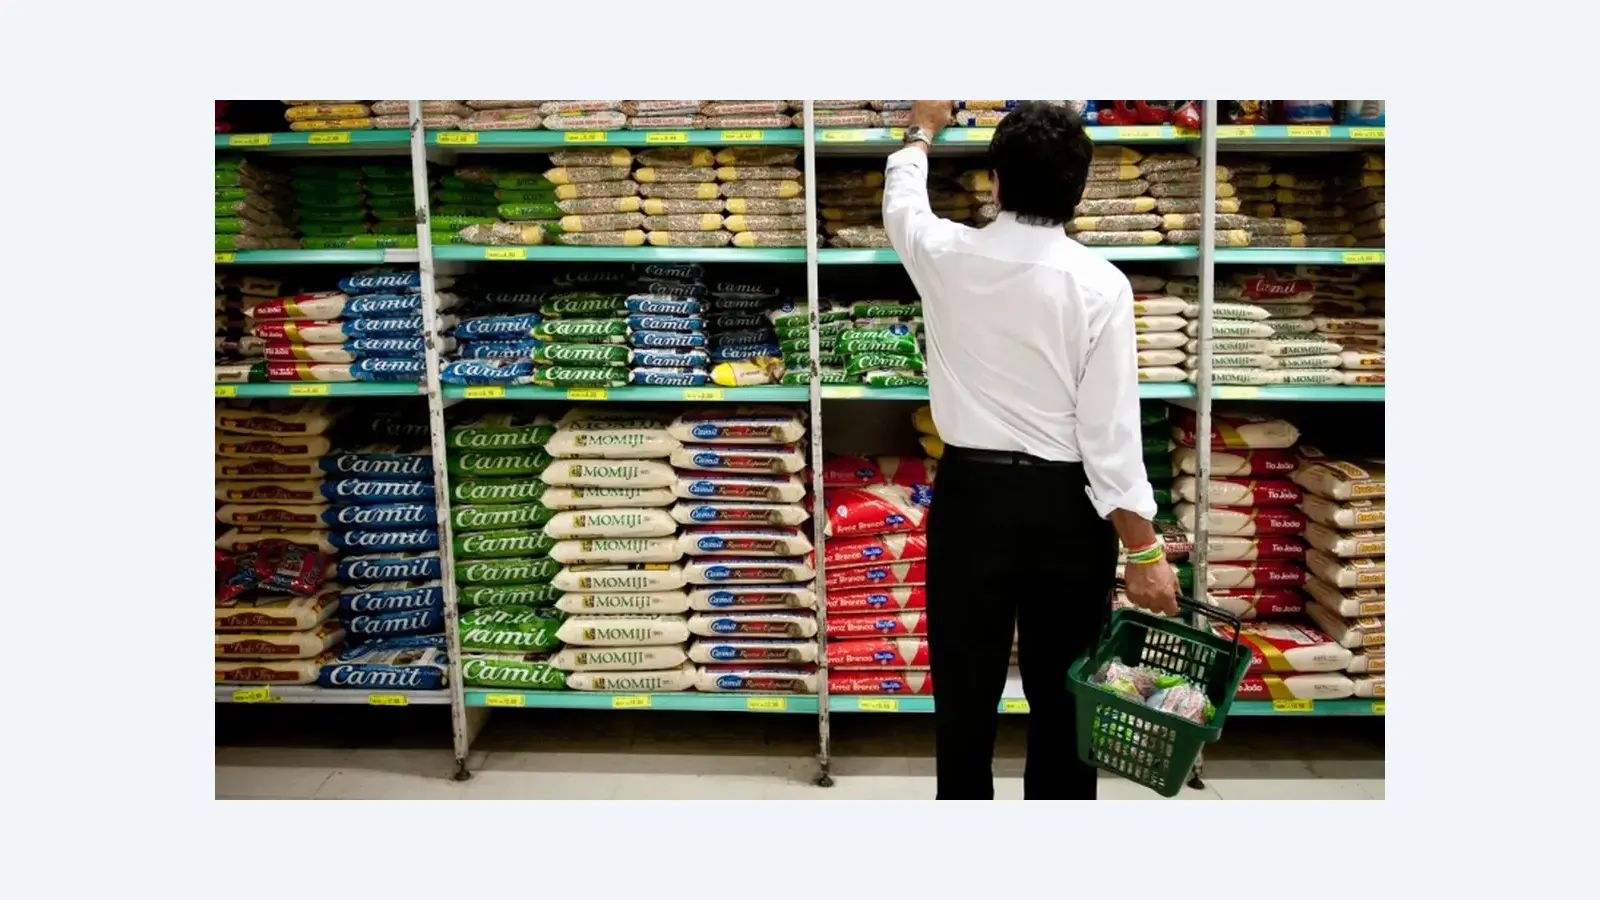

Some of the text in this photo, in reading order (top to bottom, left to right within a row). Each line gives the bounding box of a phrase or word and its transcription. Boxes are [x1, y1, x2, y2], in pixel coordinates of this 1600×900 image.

[645, 264, 692, 277] Camil
[348, 273, 413, 288] Camil
[648, 282, 696, 297] Camil
[351, 297, 420, 313] Camil
[553, 296, 618, 312] Camil
[639, 301, 689, 315] Camil
[867, 306, 916, 316] Camil
[354, 316, 423, 331] Camil
[466, 318, 528, 333] Camil
[543, 321, 614, 335] Camil
[640, 317, 690, 331] Camil
[354, 337, 422, 351] Camil
[643, 333, 694, 347] Camil
[544, 344, 614, 360] Camil
[643, 353, 694, 367] Camil
[453, 362, 520, 377] Camil
[545, 366, 616, 381] Camil
[645, 373, 696, 386] Camil
[455, 428, 541, 447] Camil
[589, 434, 644, 449] MOMIJI
[337, 454, 425, 474] Camil
[459, 452, 544, 470] Camil
[584, 467, 639, 480] MOMIJI
[337, 478, 425, 497] Camil
[455, 480, 540, 499] Camil
[585, 487, 640, 499] MOMIJI
[338, 505, 426, 524] Camil
[456, 505, 541, 527] Camil
[587, 514, 642, 528] MOMIJI
[345, 529, 431, 547] Camil
[463, 532, 548, 553] Camil
[594, 538, 649, 553] MOMIJI
[348, 557, 432, 579] Camil
[466, 561, 550, 582] Camil
[593, 577, 648, 591] MOMIJI
[350, 589, 436, 612] Camil
[473, 584, 560, 607] Camil
[596, 596, 651, 609] MOMIJI
[350, 611, 430, 634] Camil
[596, 628, 651, 642] MOMIJI
[589, 652, 644, 666] MOMIJI
[331, 665, 421, 687] Camil
[462, 659, 556, 684] Camil
[607, 678, 661, 691] MOMIJI
